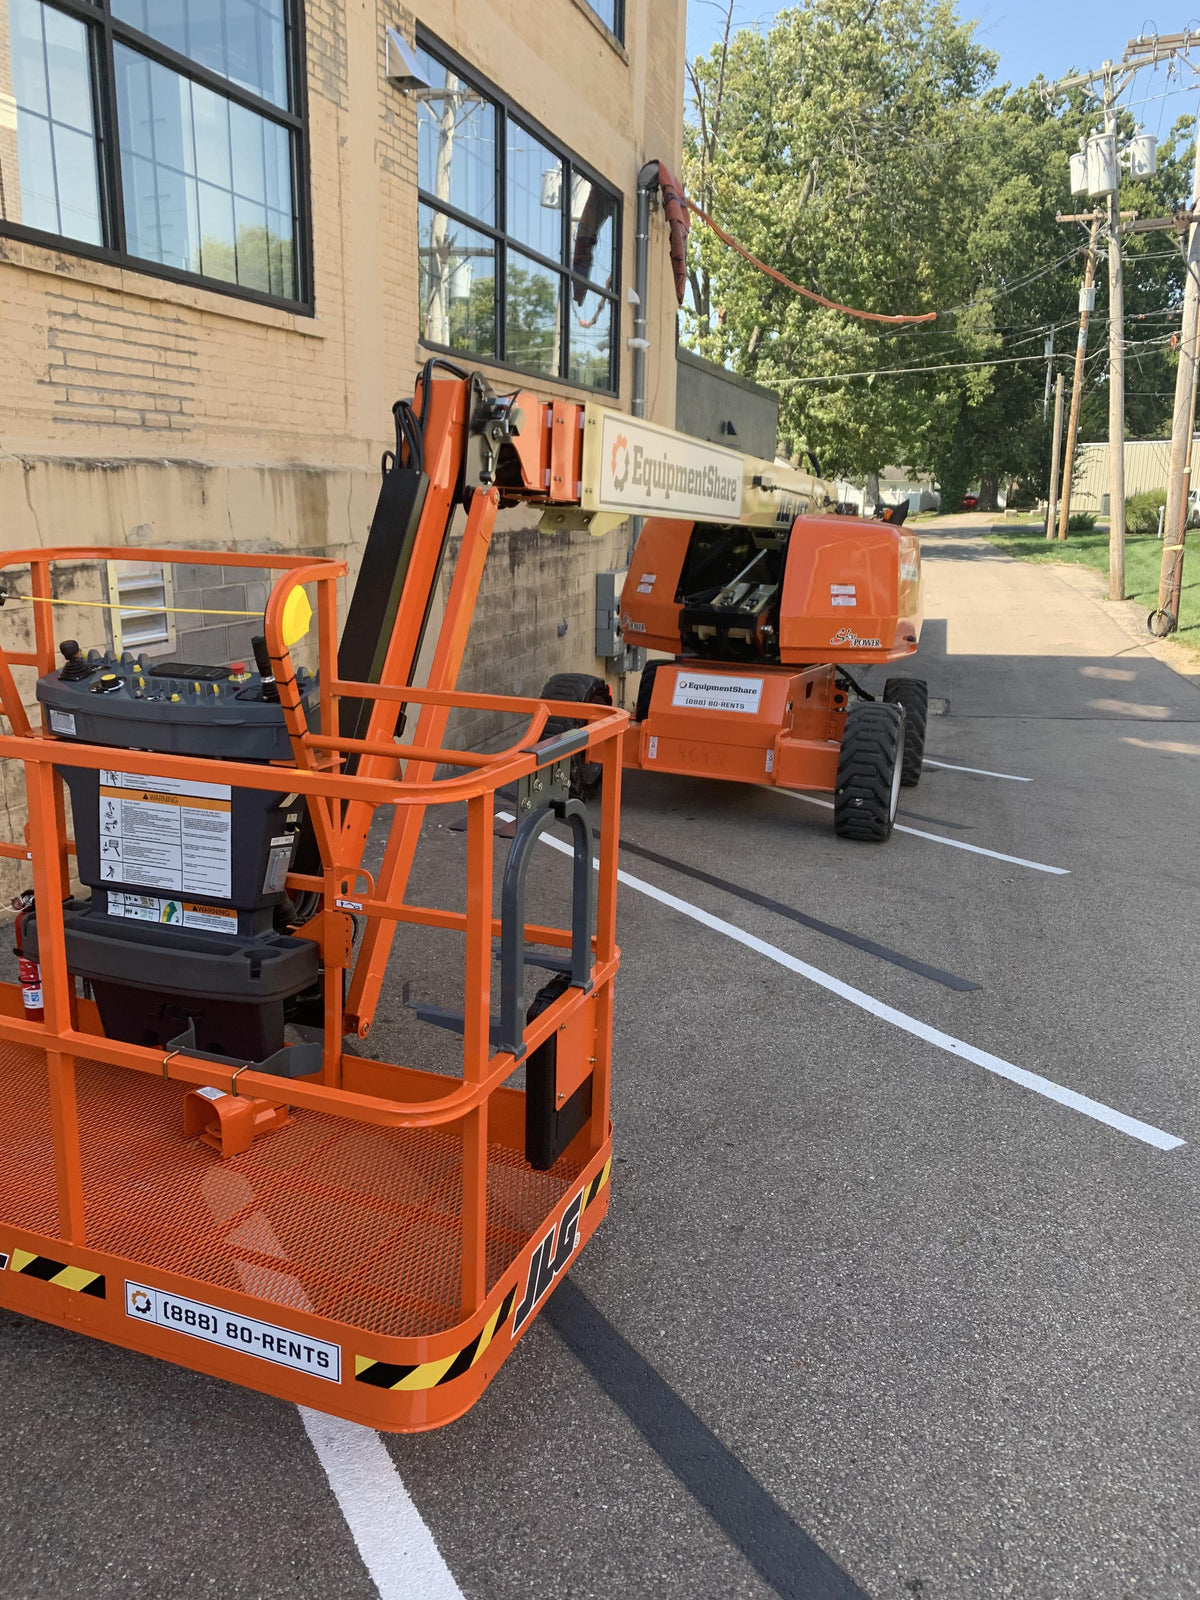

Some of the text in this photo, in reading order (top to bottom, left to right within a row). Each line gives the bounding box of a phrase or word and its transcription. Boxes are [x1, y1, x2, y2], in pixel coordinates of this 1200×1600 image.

[632, 444, 737, 502] EquipmentShare
[688, 681, 757, 695] EquipmentShare
[685, 697, 745, 710] (888) 80-RENTS
[149, 793, 179, 805] WARNING
[197, 905, 231, 918] WARNING
[511, 1185, 584, 1339] JLG
[163, 1301, 330, 1369] (888) 80-RENTS
